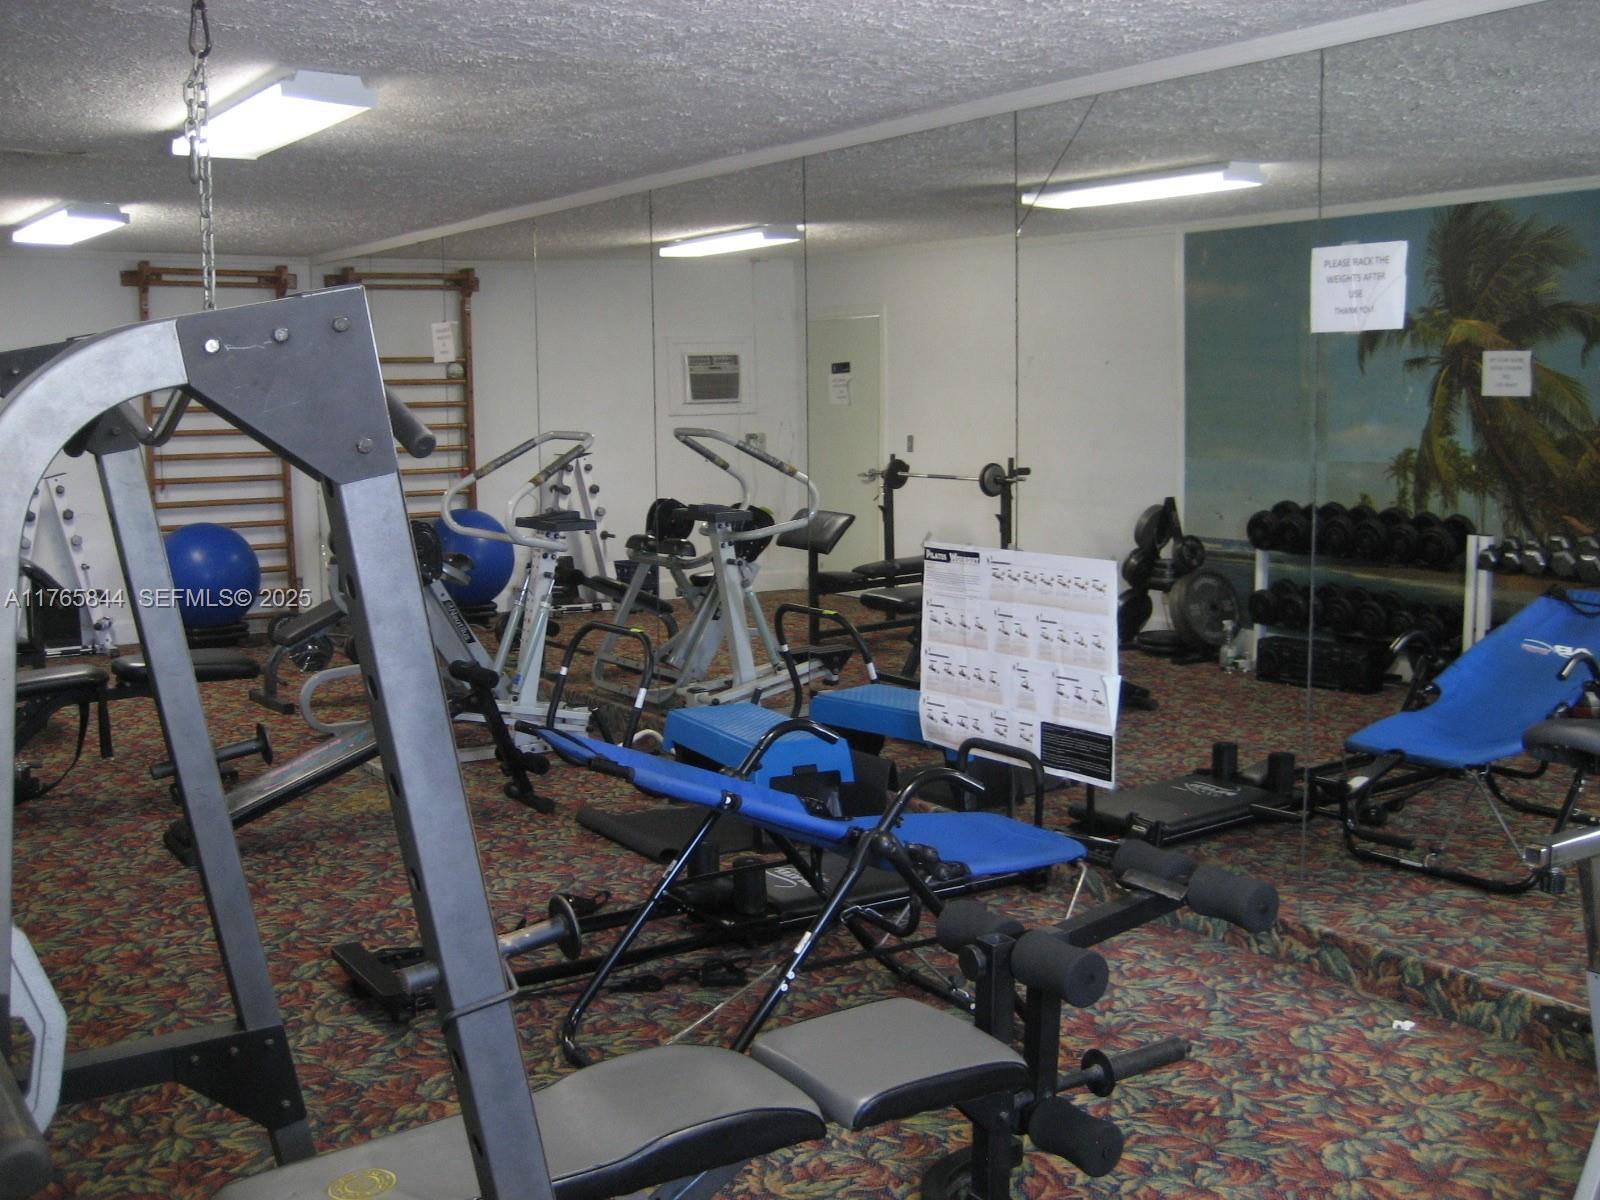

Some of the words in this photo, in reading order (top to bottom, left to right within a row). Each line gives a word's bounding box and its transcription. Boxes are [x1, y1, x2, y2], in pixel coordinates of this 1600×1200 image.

[1324, 258, 1351, 269] PLEASE
[1352, 256, 1374, 266] RACK
[1375, 254, 1391, 265] THE
[1326, 273, 1361, 284] WEIGHTS
[1363, 271, 1386, 281] AFTER
[1348, 288, 1363, 299] USE
[1334, 306, 1358, 315] THANK
